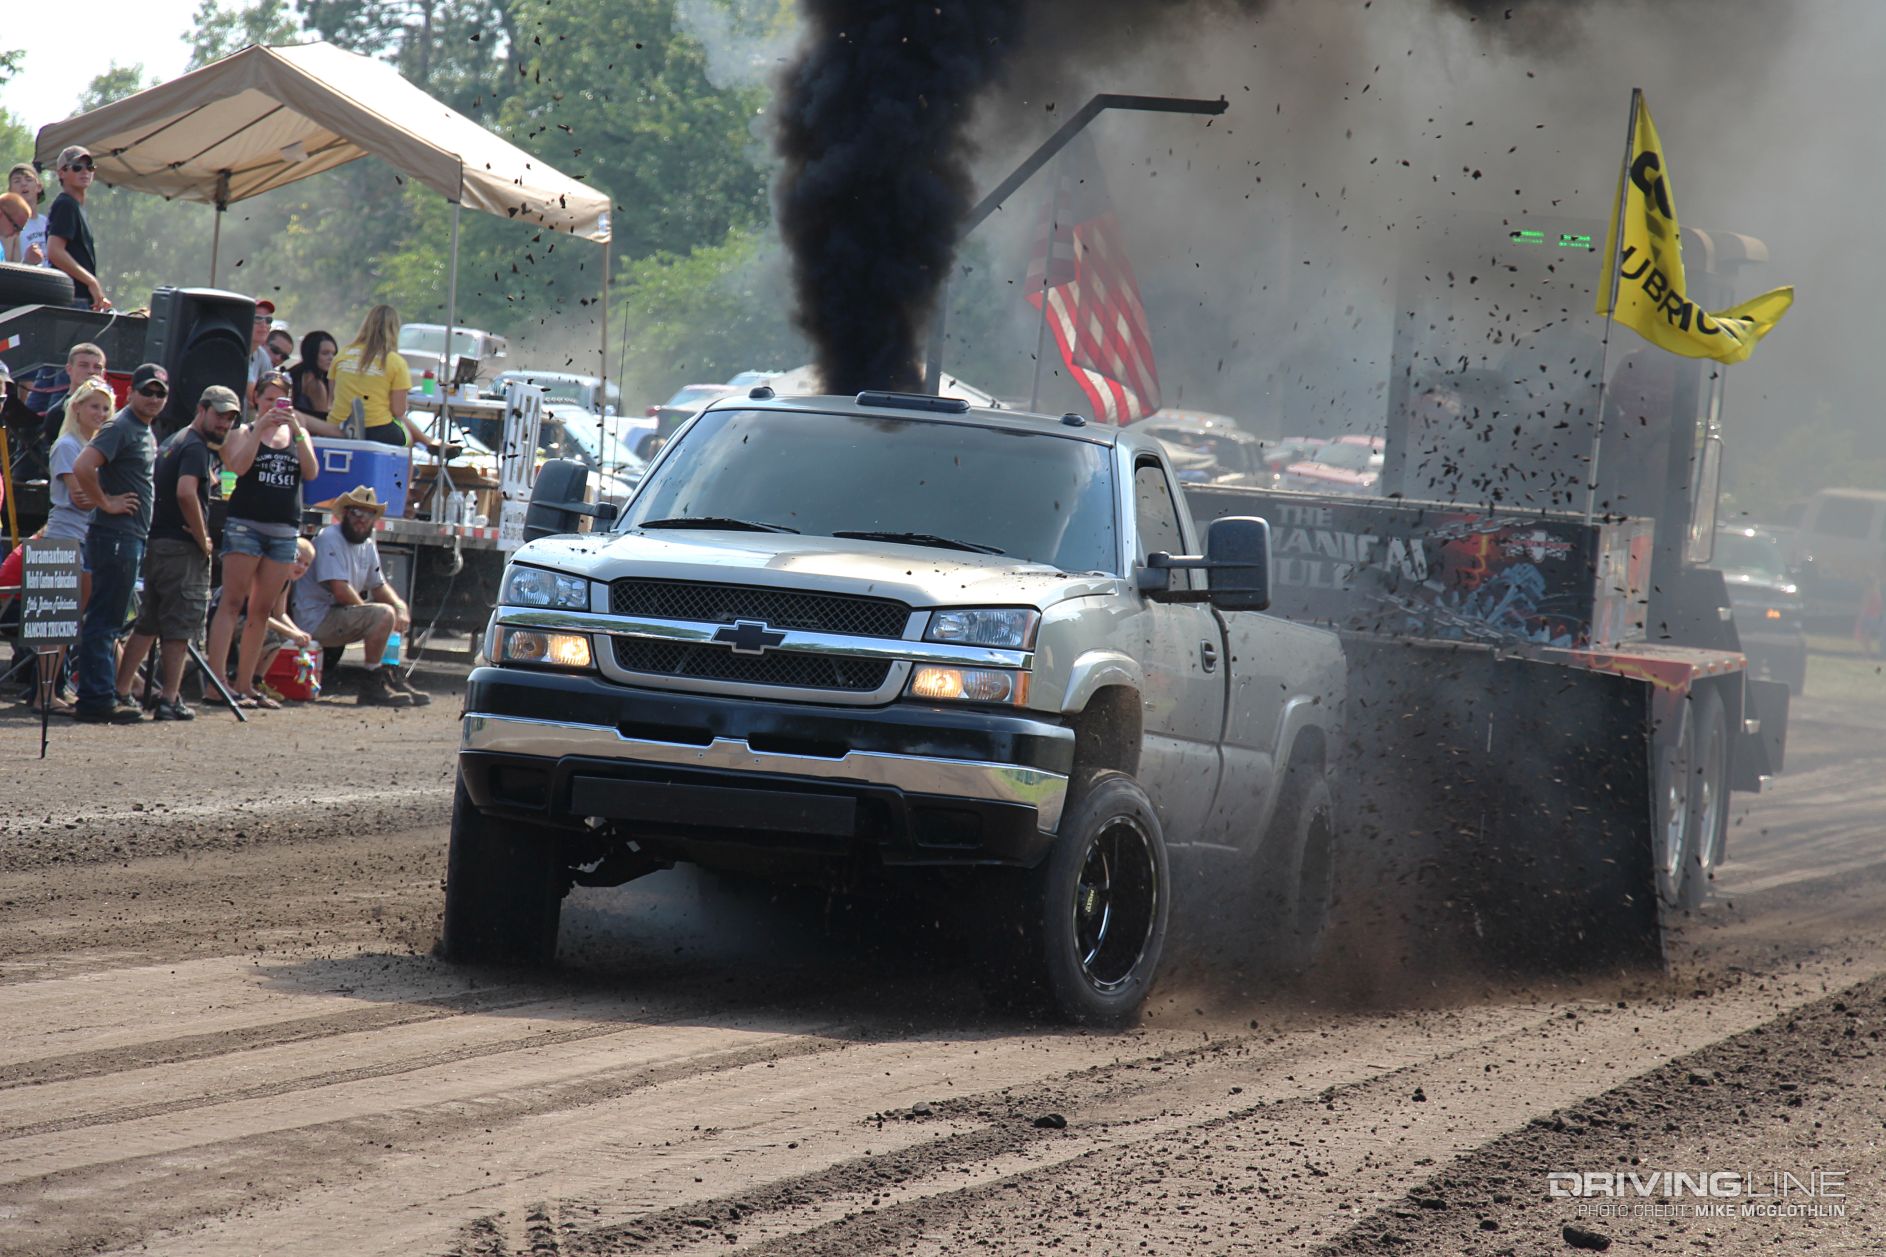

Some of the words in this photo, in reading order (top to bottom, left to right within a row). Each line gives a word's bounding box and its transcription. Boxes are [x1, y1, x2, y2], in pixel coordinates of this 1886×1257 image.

[258, 471, 294, 485] DIESEL
[1275, 504, 1333, 526] THE
[26, 545, 76, 564] Duramaxtuner
[47, 621, 78, 637] TRUCKING
